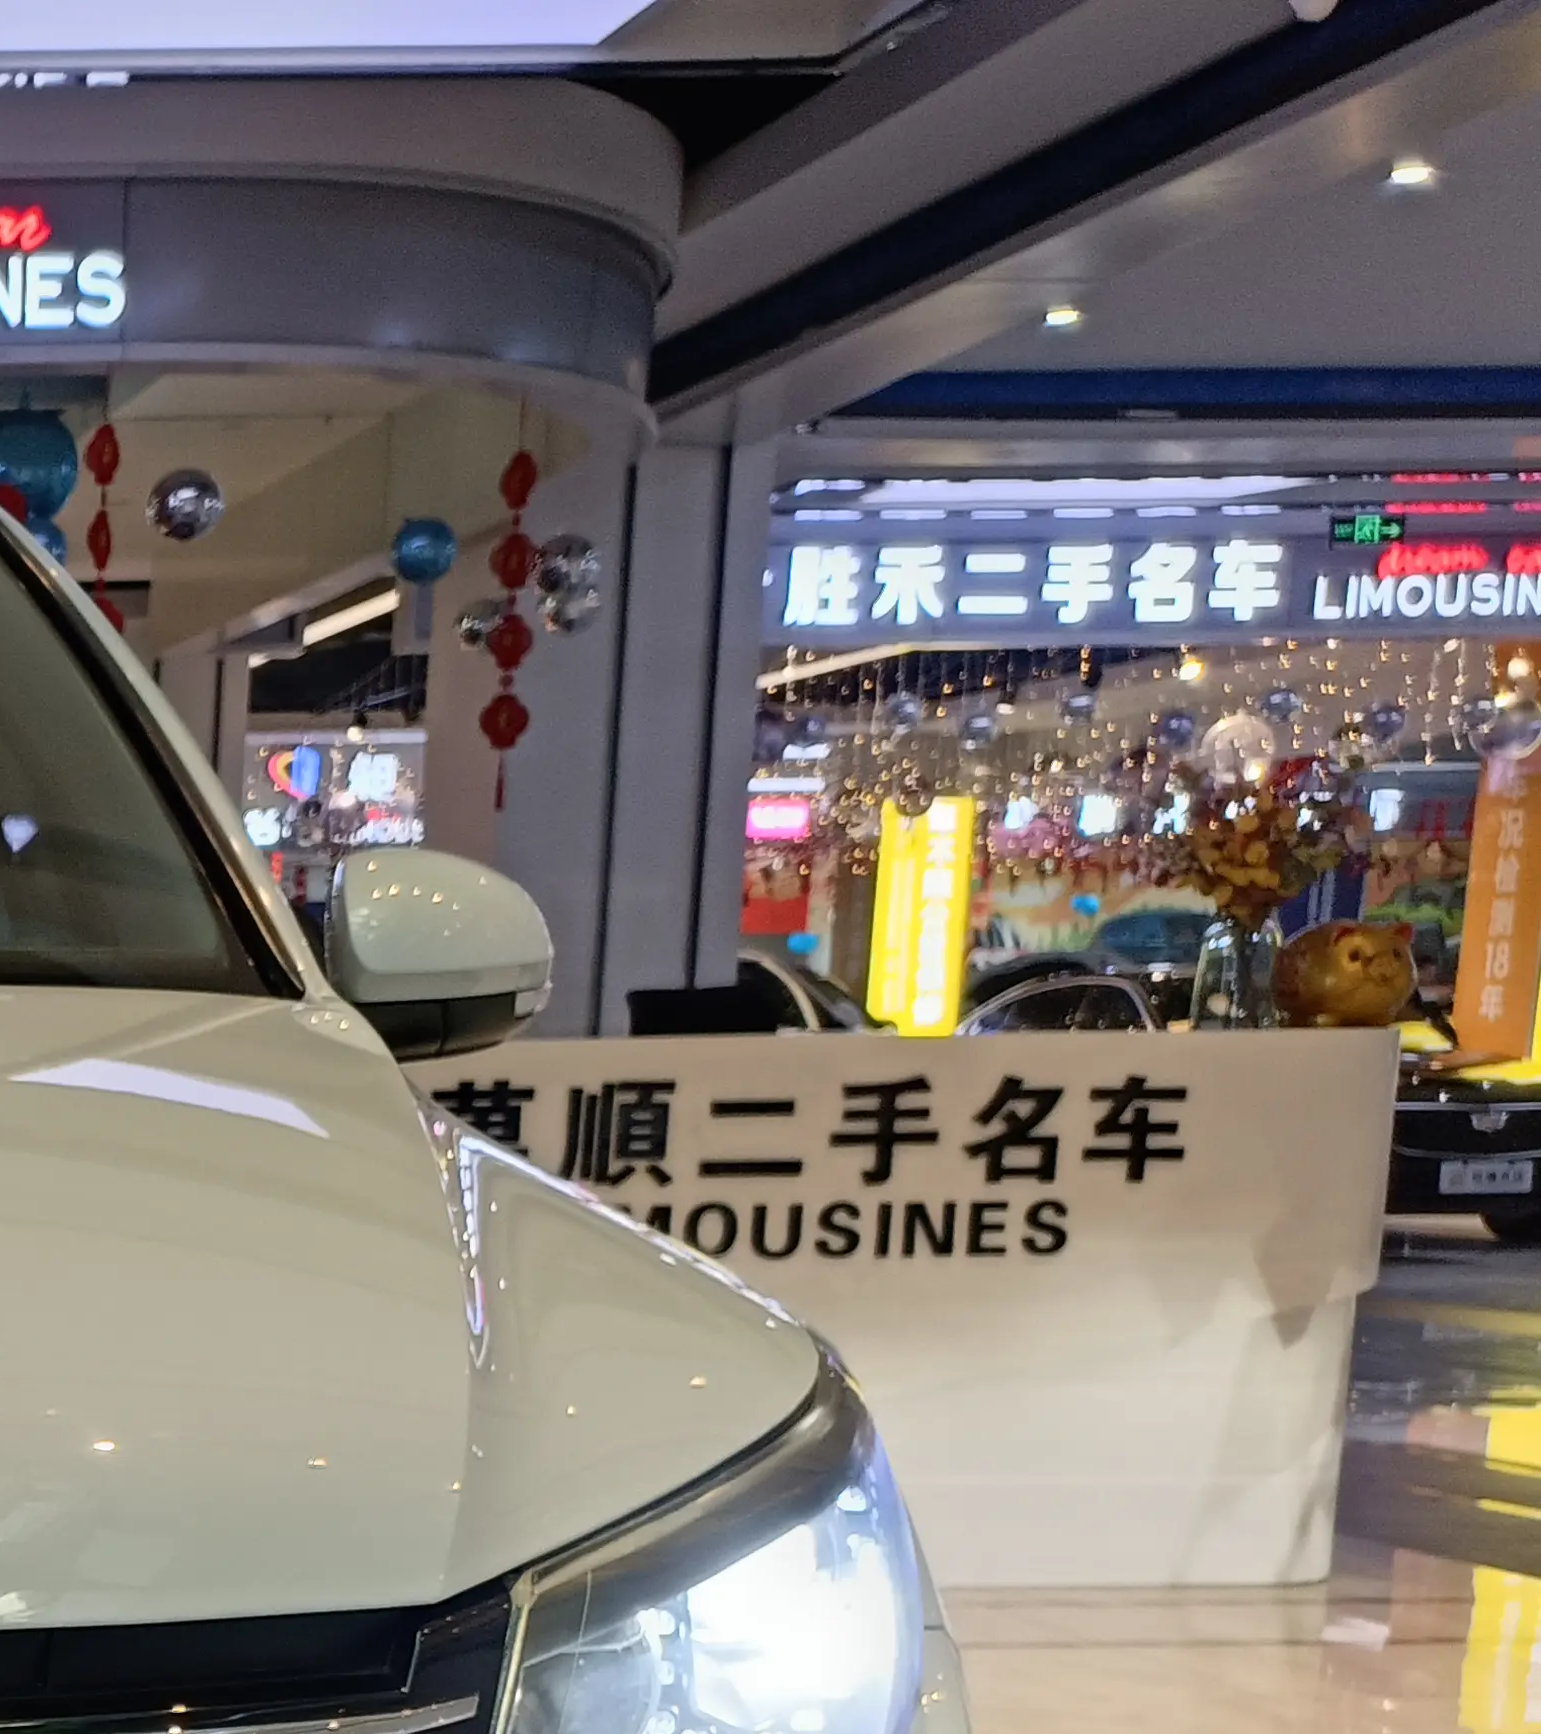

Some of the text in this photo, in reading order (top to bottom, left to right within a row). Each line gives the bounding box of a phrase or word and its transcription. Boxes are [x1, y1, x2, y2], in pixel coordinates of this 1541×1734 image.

[783, 539, 1283, 627] 胜禾二手名车
